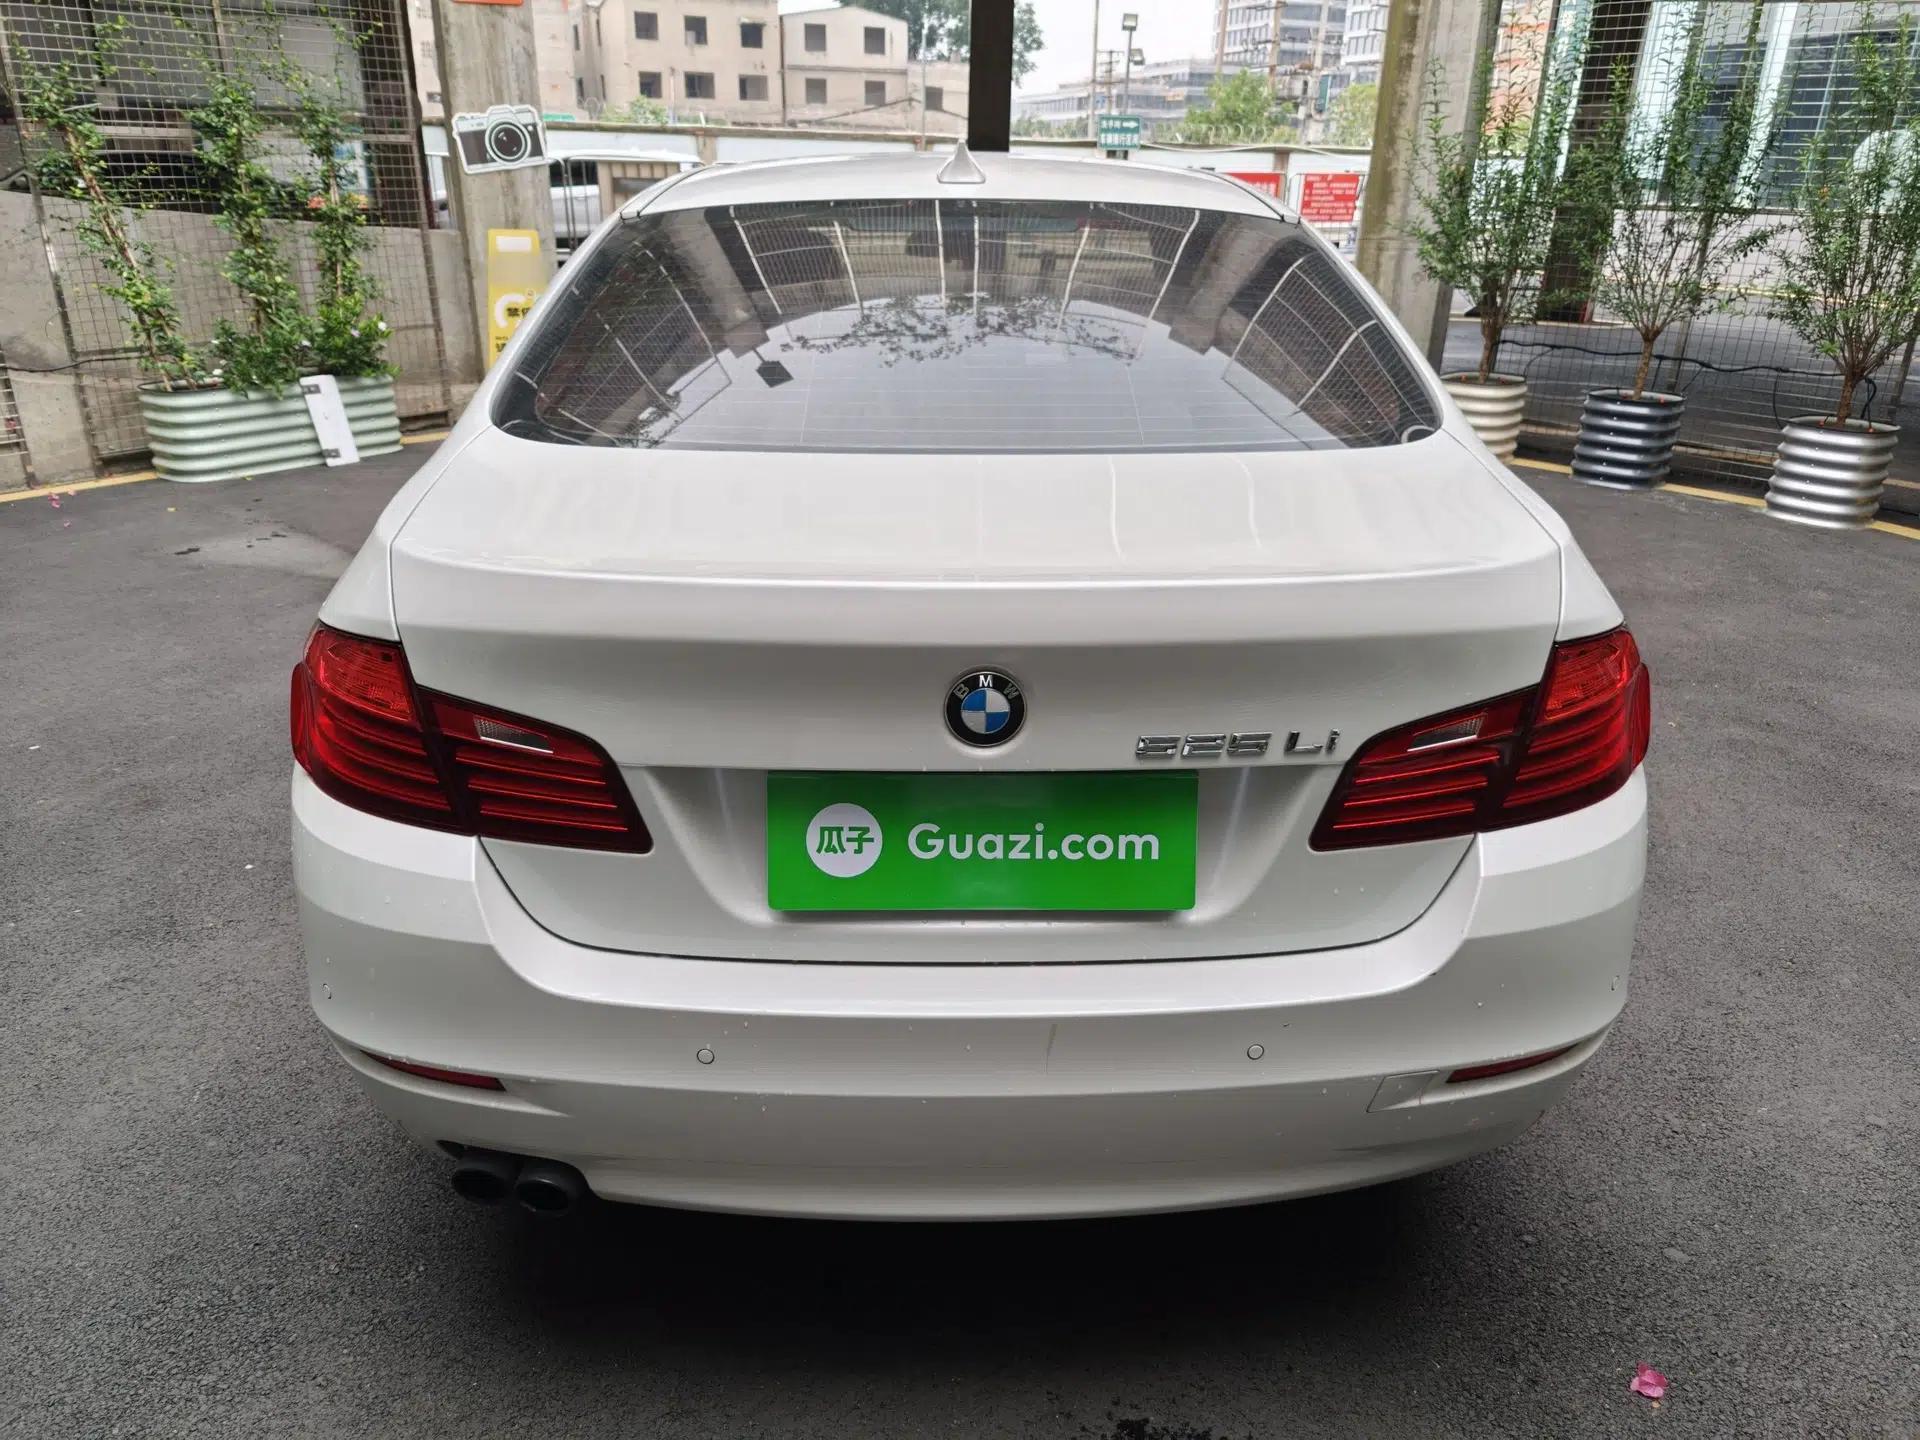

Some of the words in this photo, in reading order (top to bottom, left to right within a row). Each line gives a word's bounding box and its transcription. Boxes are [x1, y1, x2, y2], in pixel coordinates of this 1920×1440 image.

[953, 674, 1020, 700] BMW
[1136, 732, 1272, 758] 525
[1285, 729, 1340, 753] Li
[816, 826, 875, 855] 瓜子
[907, 822, 1160, 860] Guazi.com
